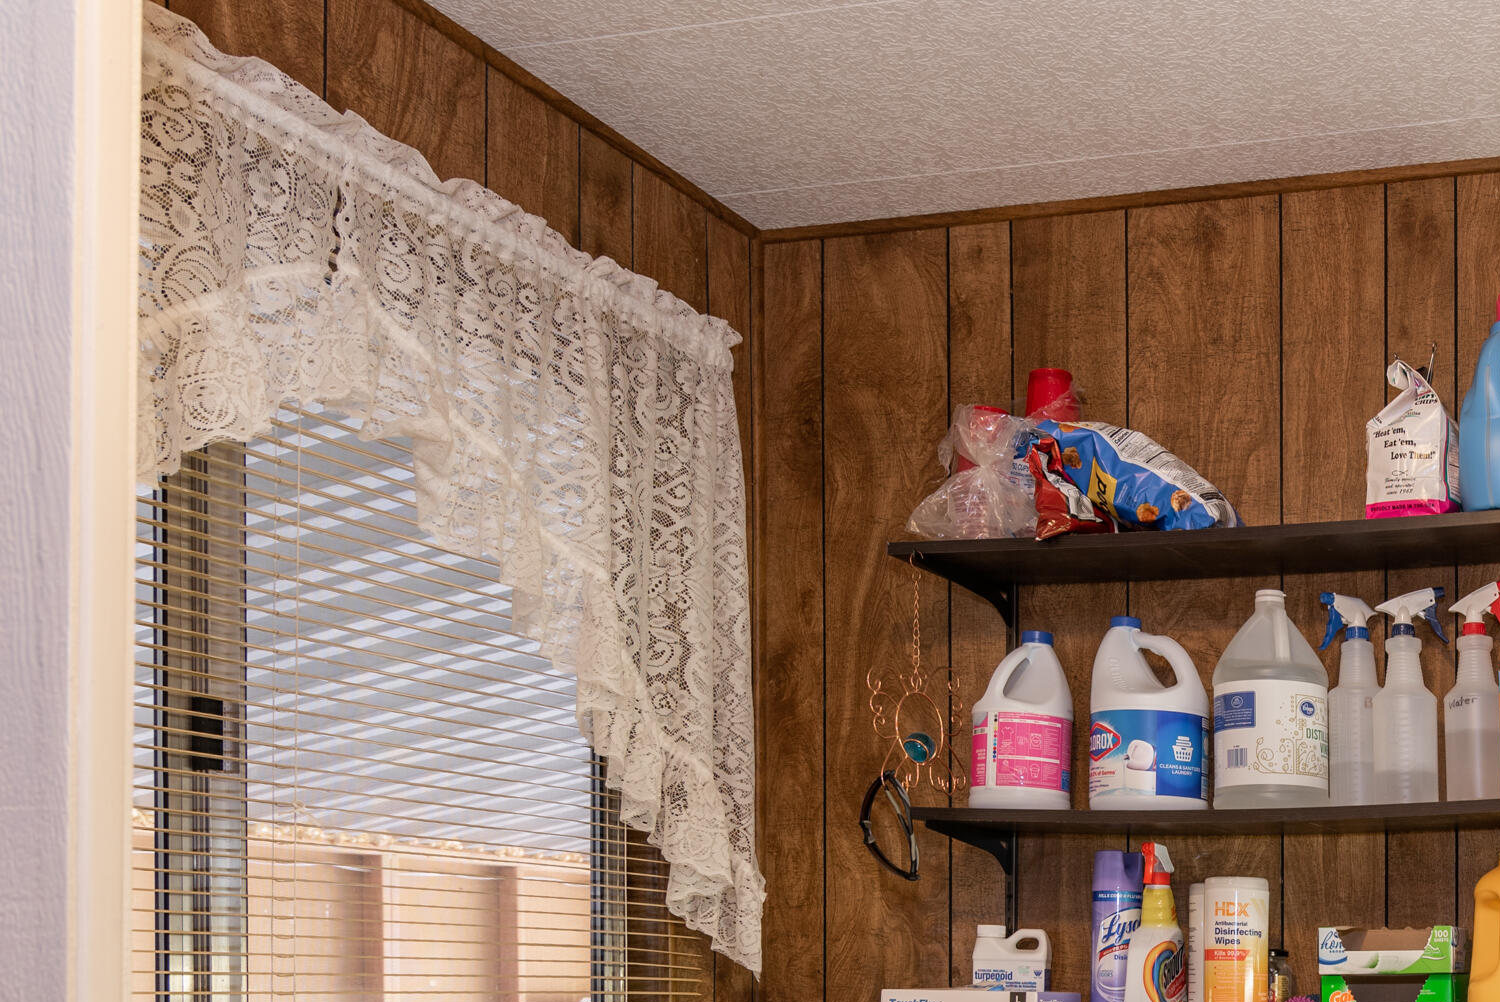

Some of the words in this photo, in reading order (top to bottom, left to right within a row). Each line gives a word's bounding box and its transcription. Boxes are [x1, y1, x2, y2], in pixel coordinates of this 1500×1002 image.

[1214, 901, 1249, 917] HDX
[1102, 914, 1140, 944] Lyso
[1214, 927, 1262, 938] Disinfecting
[1214, 937, 1241, 946] Wipes
